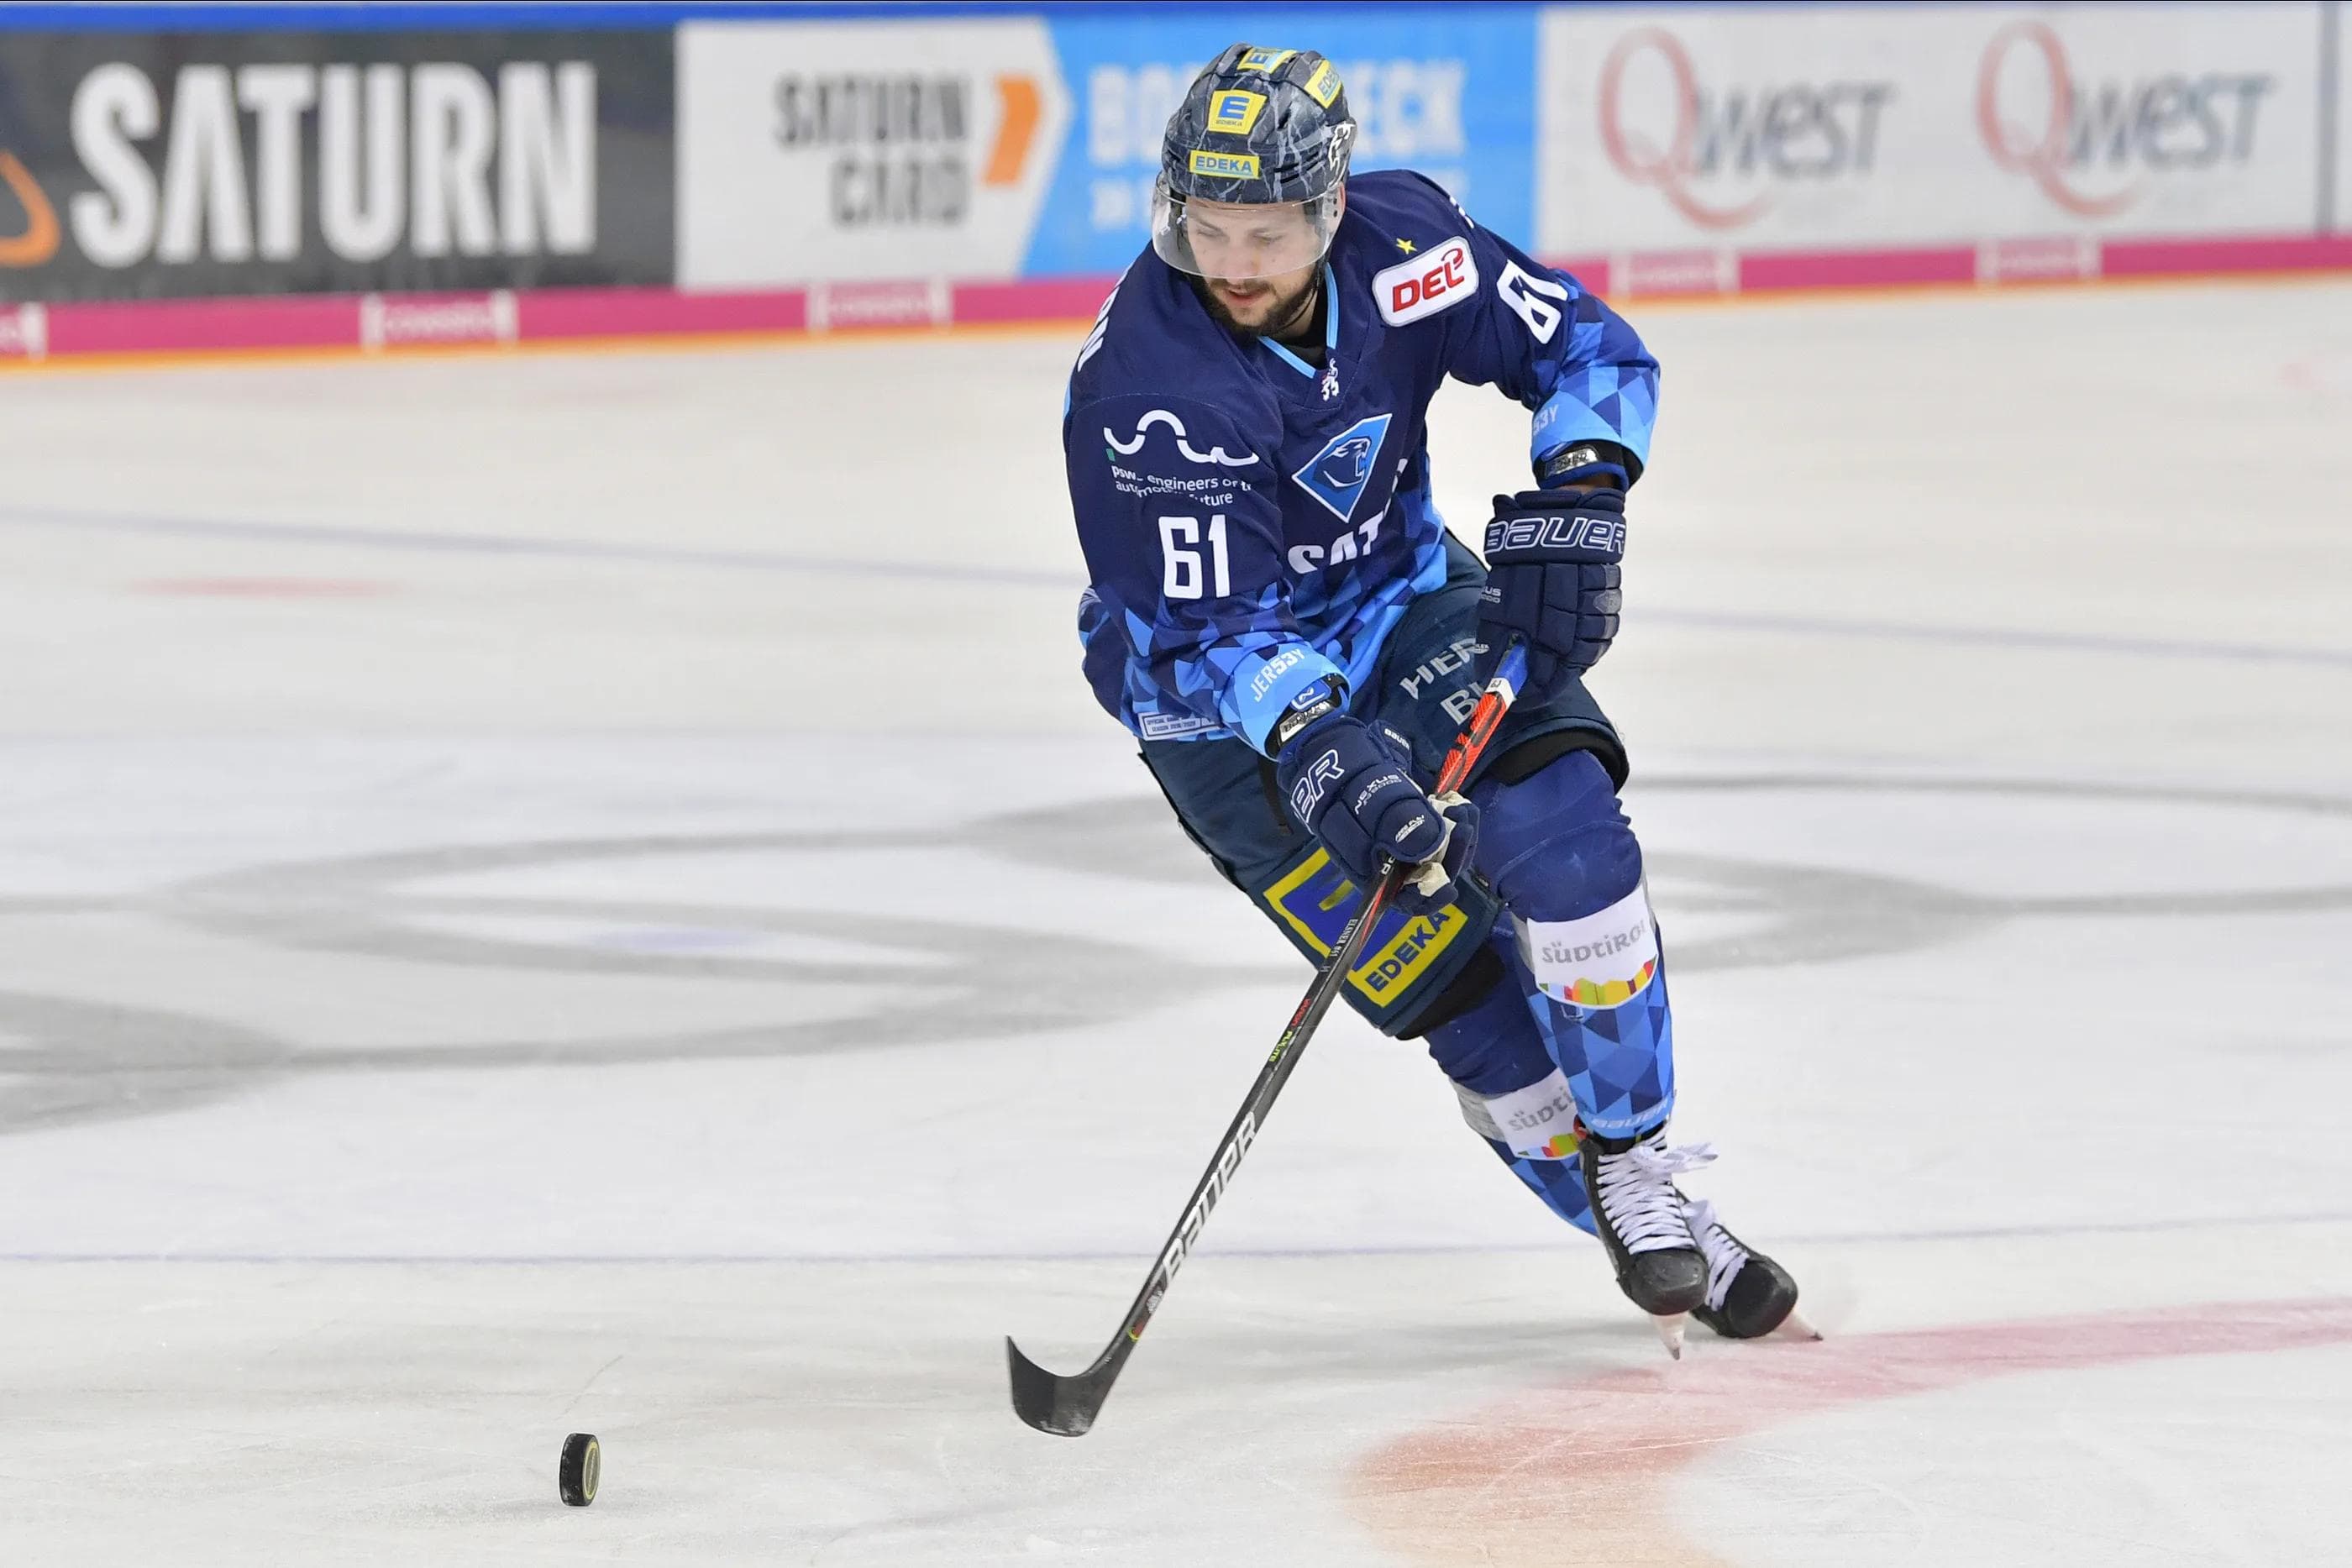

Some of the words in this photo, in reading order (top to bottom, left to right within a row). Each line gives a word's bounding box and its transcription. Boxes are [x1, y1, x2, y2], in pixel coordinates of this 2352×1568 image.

[775, 74, 971, 149] SATURN
[1218, 96, 1250, 119] E
[71, 62, 597, 266] SATURN
[1195, 155, 1252, 172] EDEKA
[832, 164, 971, 225] CARD
[1392, 256, 1465, 313] DEL
[1147, 474, 1219, 491] engineers
[1158, 514, 1231, 599] 61
[1365, 911, 1449, 993] EDEKA
